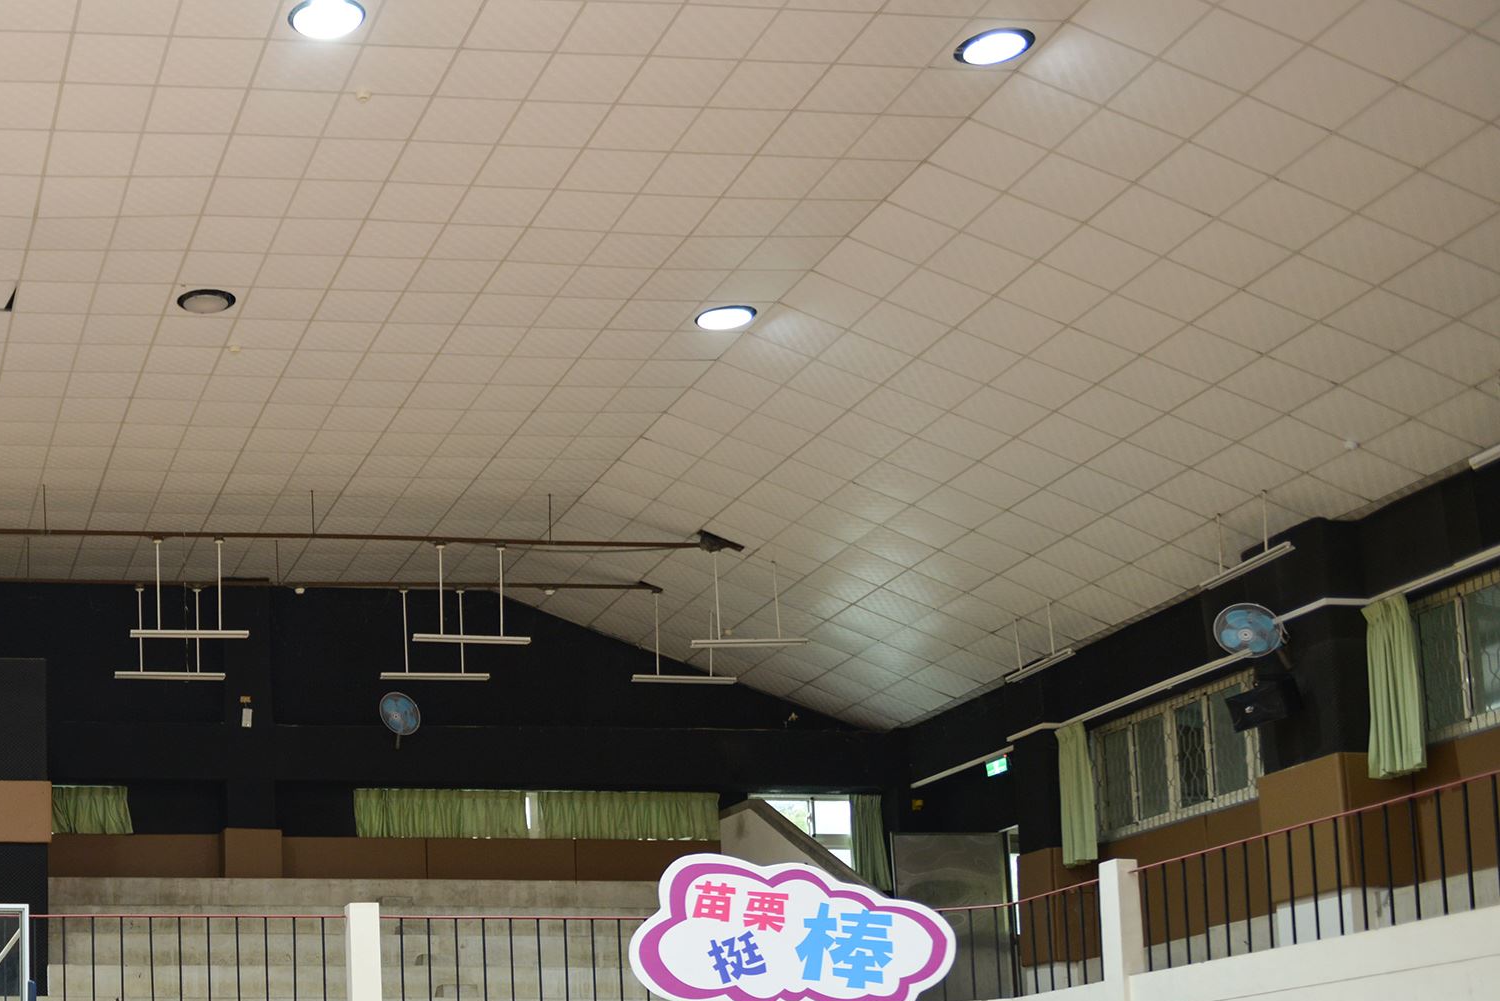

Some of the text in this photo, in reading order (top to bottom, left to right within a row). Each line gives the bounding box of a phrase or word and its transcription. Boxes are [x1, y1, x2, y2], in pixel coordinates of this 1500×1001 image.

[692, 880, 789, 933] 苗栗
[707, 931, 767, 984] 挺
[795, 902, 893, 989] 棒
